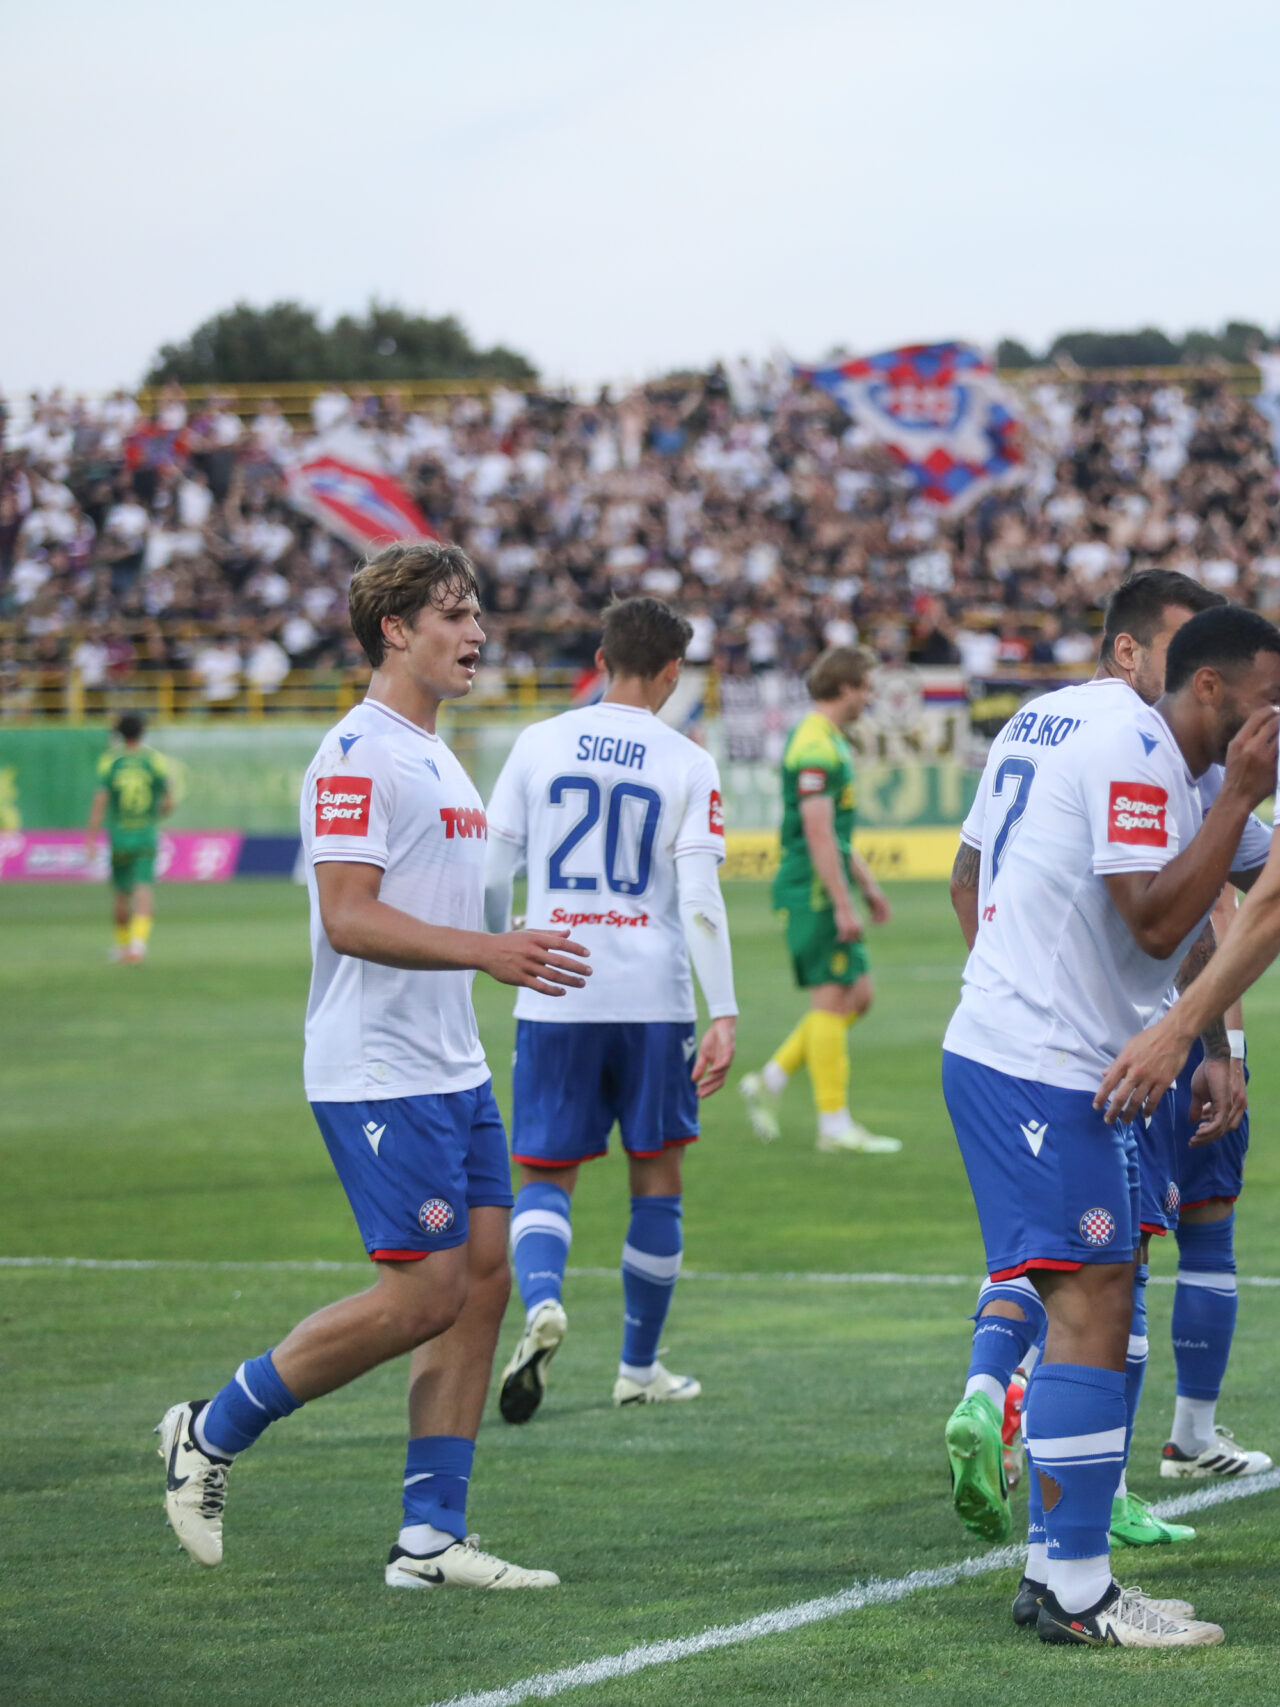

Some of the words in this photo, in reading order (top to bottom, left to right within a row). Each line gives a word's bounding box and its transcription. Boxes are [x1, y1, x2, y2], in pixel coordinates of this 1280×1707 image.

[577, 735, 647, 770] SIGUR
[318, 791, 367, 805] Super
[1113, 796, 1164, 815] Super
[320, 806, 363, 821] Sport
[546, 772, 664, 897] 20
[1083, 1210, 1111, 1222] HAJDUK
[1086, 1235, 1109, 1245] SPLIT
